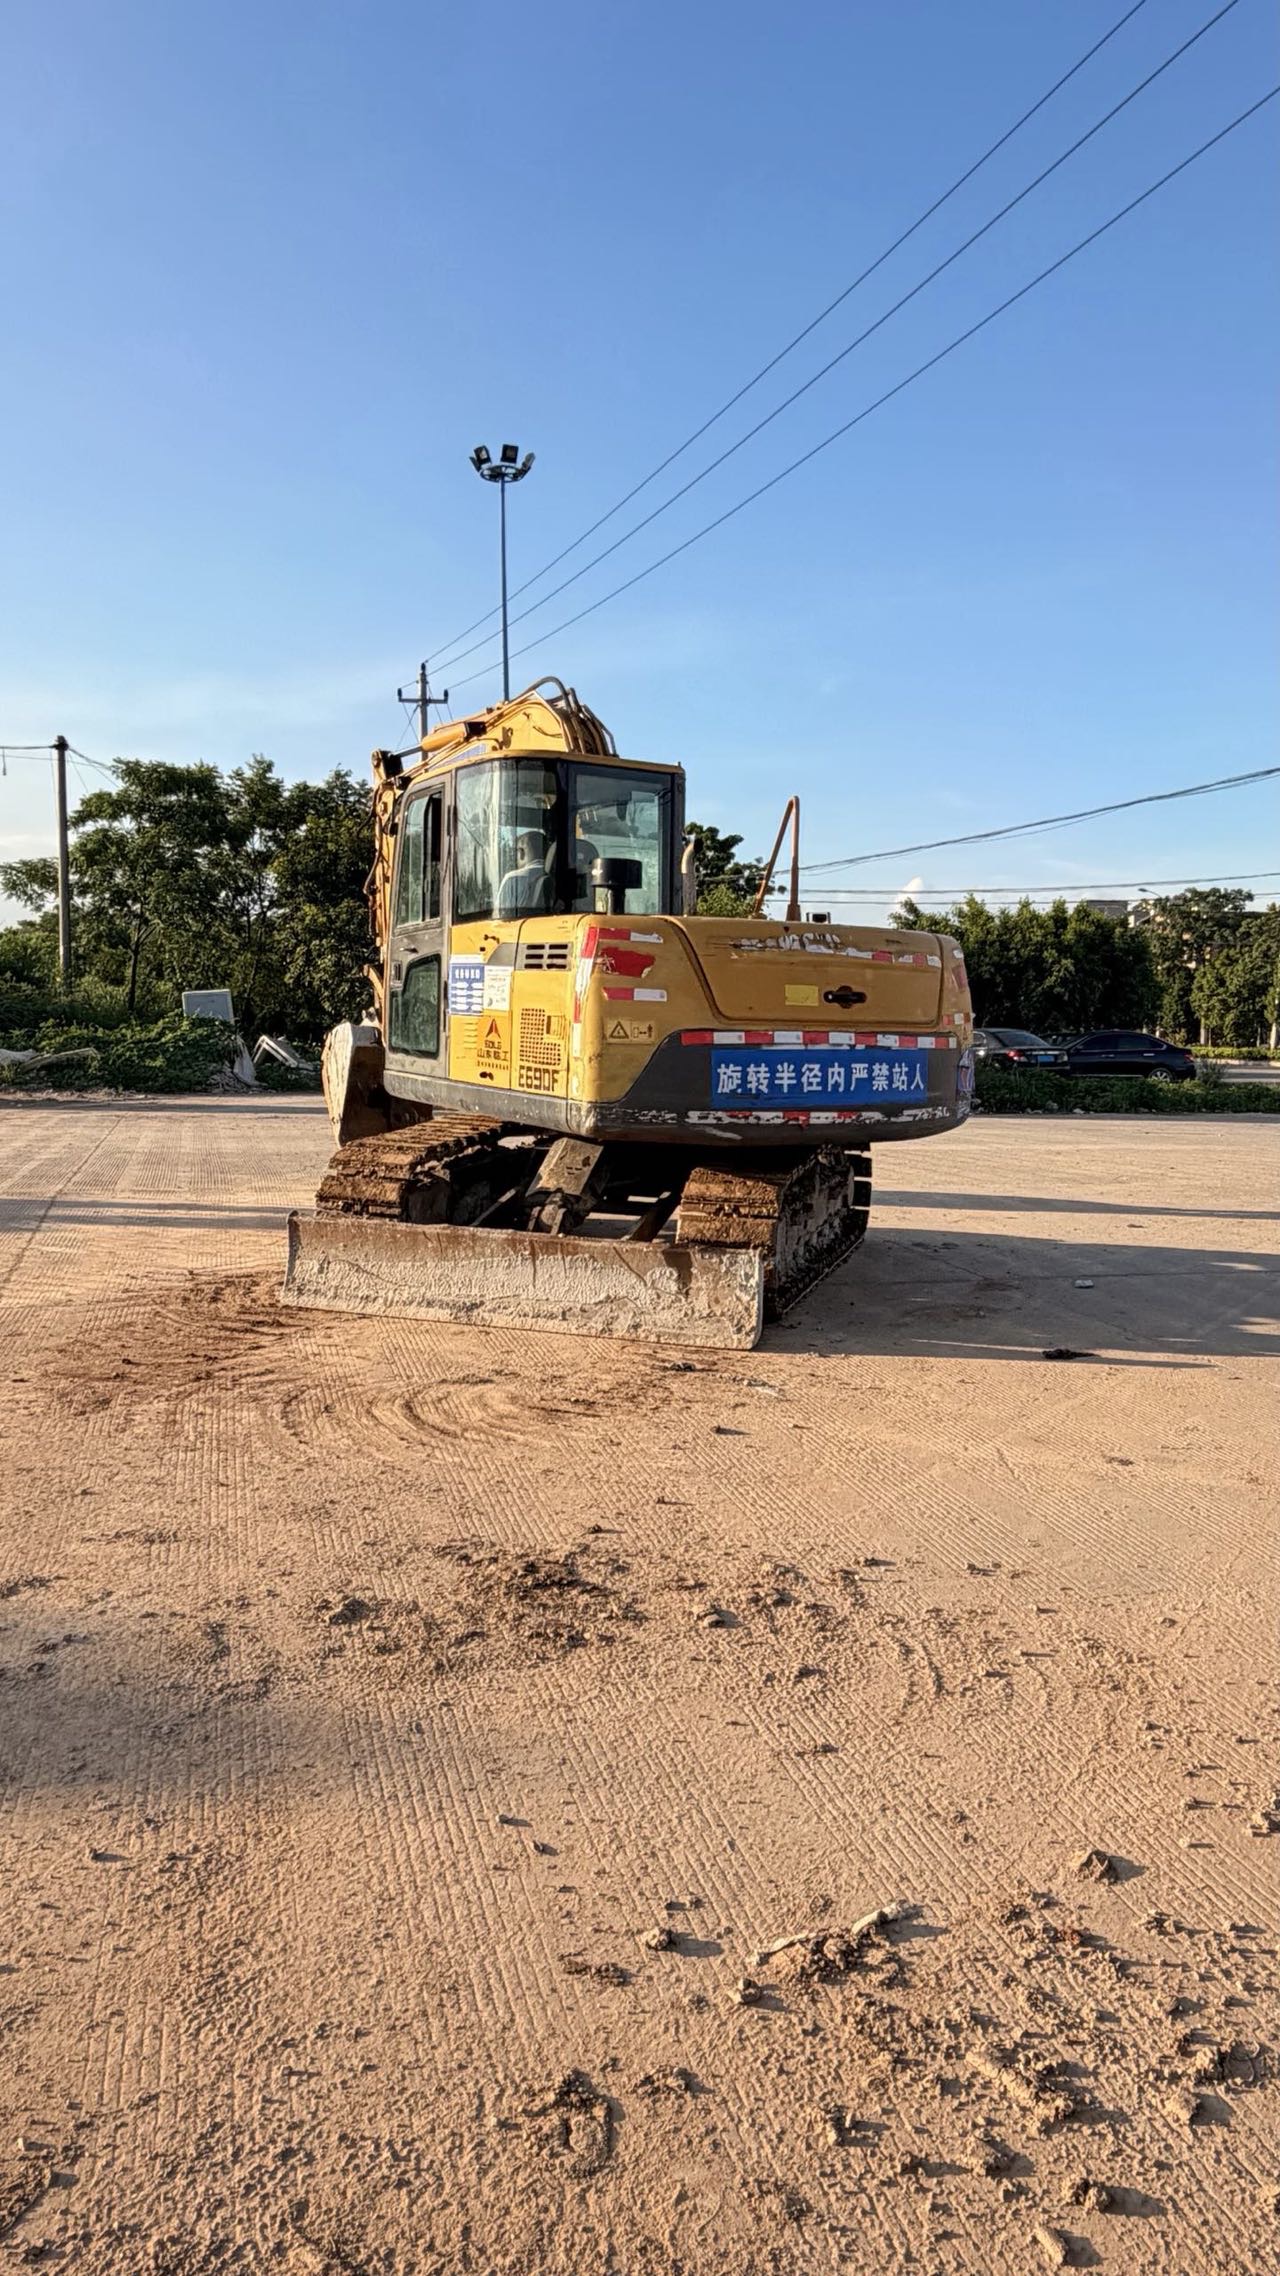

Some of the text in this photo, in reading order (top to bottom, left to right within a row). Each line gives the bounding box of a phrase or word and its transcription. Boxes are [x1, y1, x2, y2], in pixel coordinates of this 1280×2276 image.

[716, 1062, 925, 1094] 旋转半径内严禁站人
